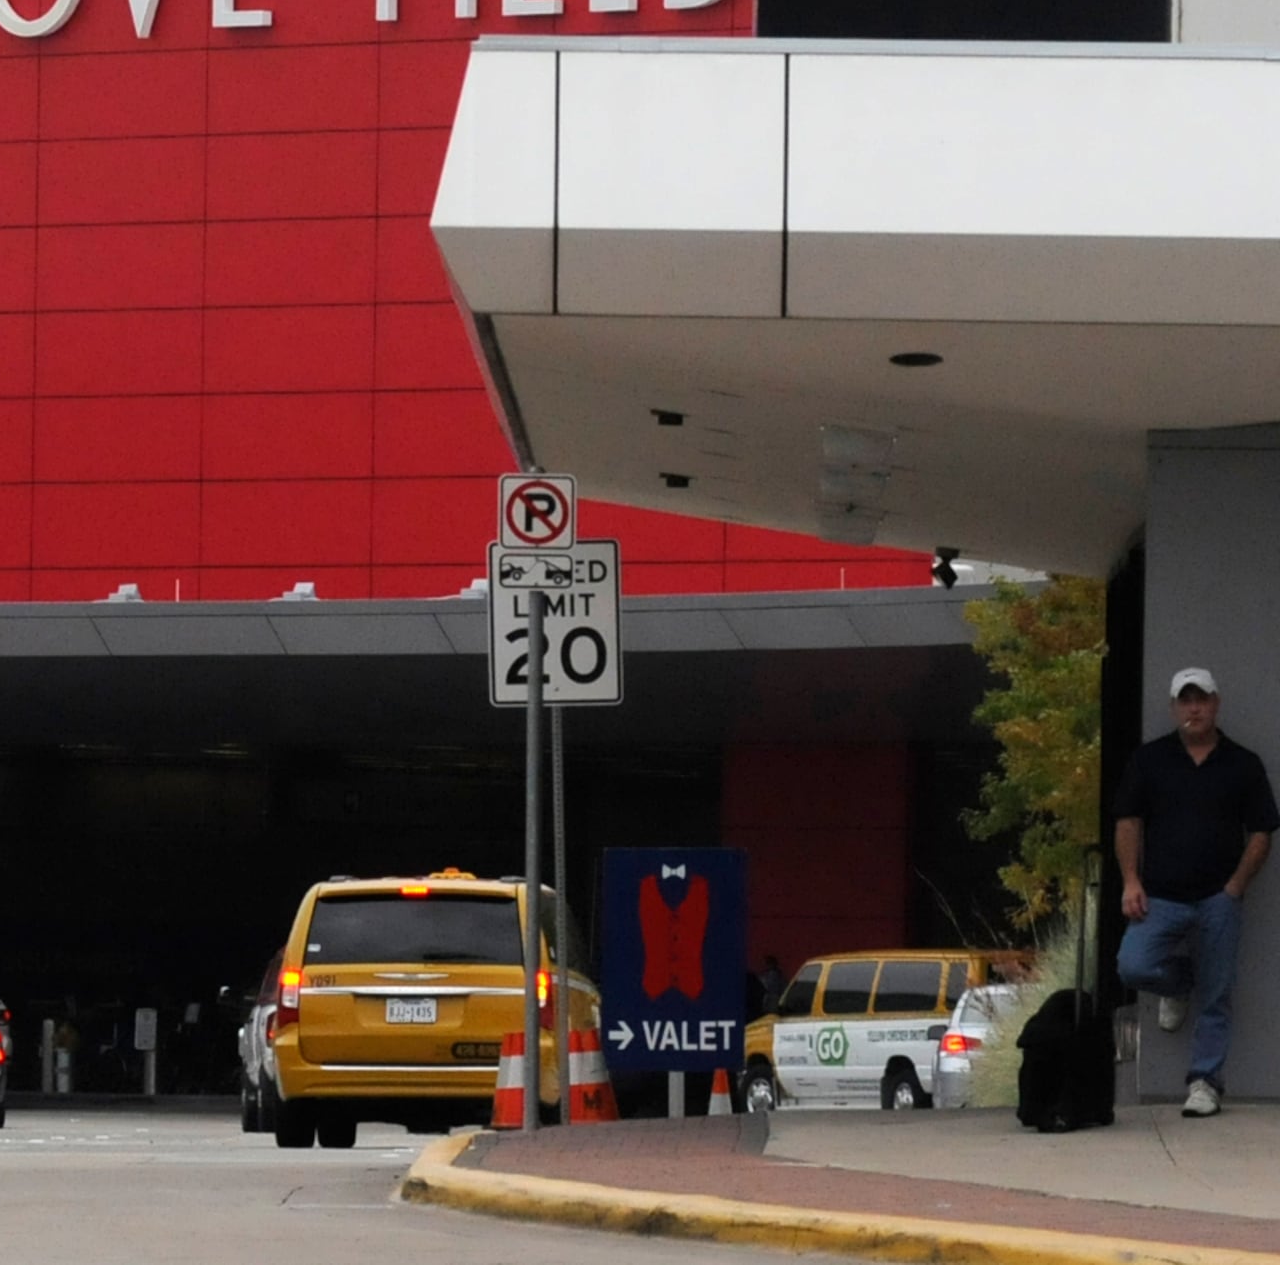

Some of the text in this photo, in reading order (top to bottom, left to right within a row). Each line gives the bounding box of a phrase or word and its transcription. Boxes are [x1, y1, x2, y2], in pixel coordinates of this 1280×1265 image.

[514, 593, 595, 617] LMIT
[505, 626, 607, 684] 20
[642, 1019, 737, 1052] VALET
[818, 1031, 844, 1060] GO
